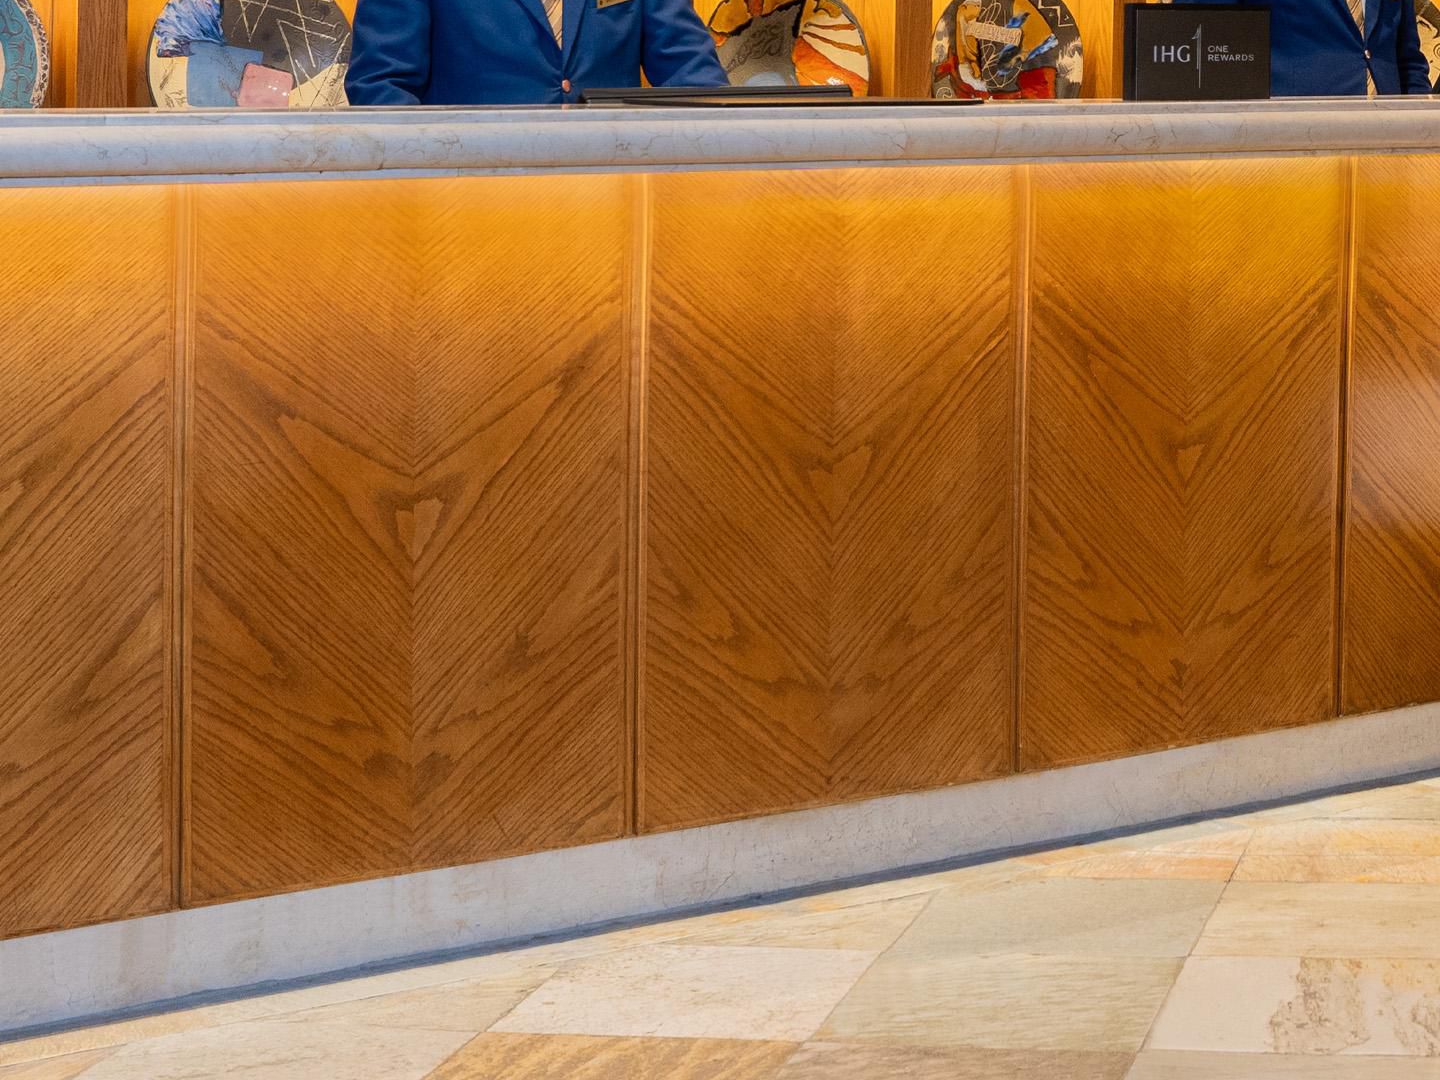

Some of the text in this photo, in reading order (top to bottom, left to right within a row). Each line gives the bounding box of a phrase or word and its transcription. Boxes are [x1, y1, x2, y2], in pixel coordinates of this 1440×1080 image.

[1207, 44, 1230, 53] ONE
[1152, 44, 1191, 63] IHG
[1207, 53, 1256, 62] REWARDS
